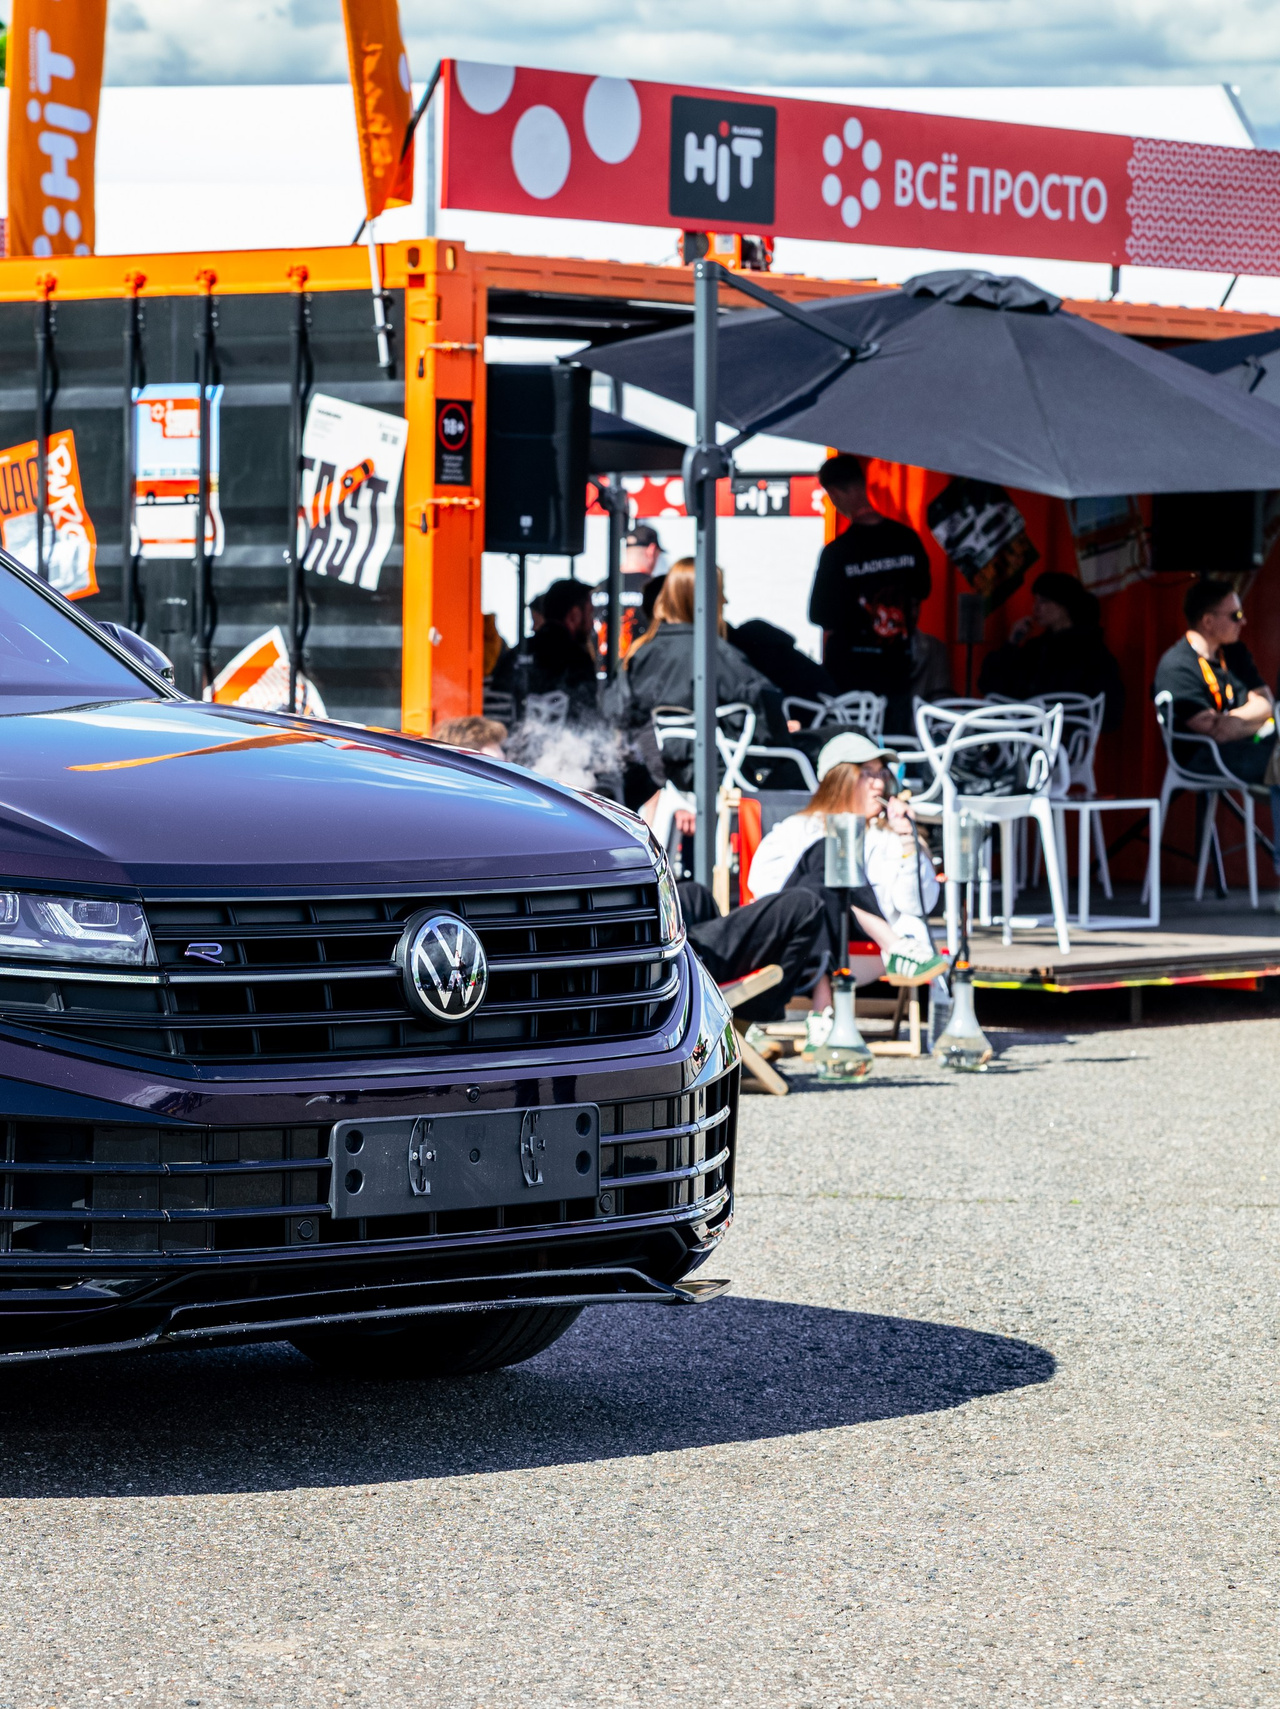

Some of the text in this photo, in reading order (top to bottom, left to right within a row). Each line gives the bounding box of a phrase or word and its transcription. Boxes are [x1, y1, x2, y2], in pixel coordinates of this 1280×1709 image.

[684, 120, 763, 203] HiT
[894, 152, 1108, 224] ВСЁ ПРОСТО
[303, 456, 389, 585] AST
